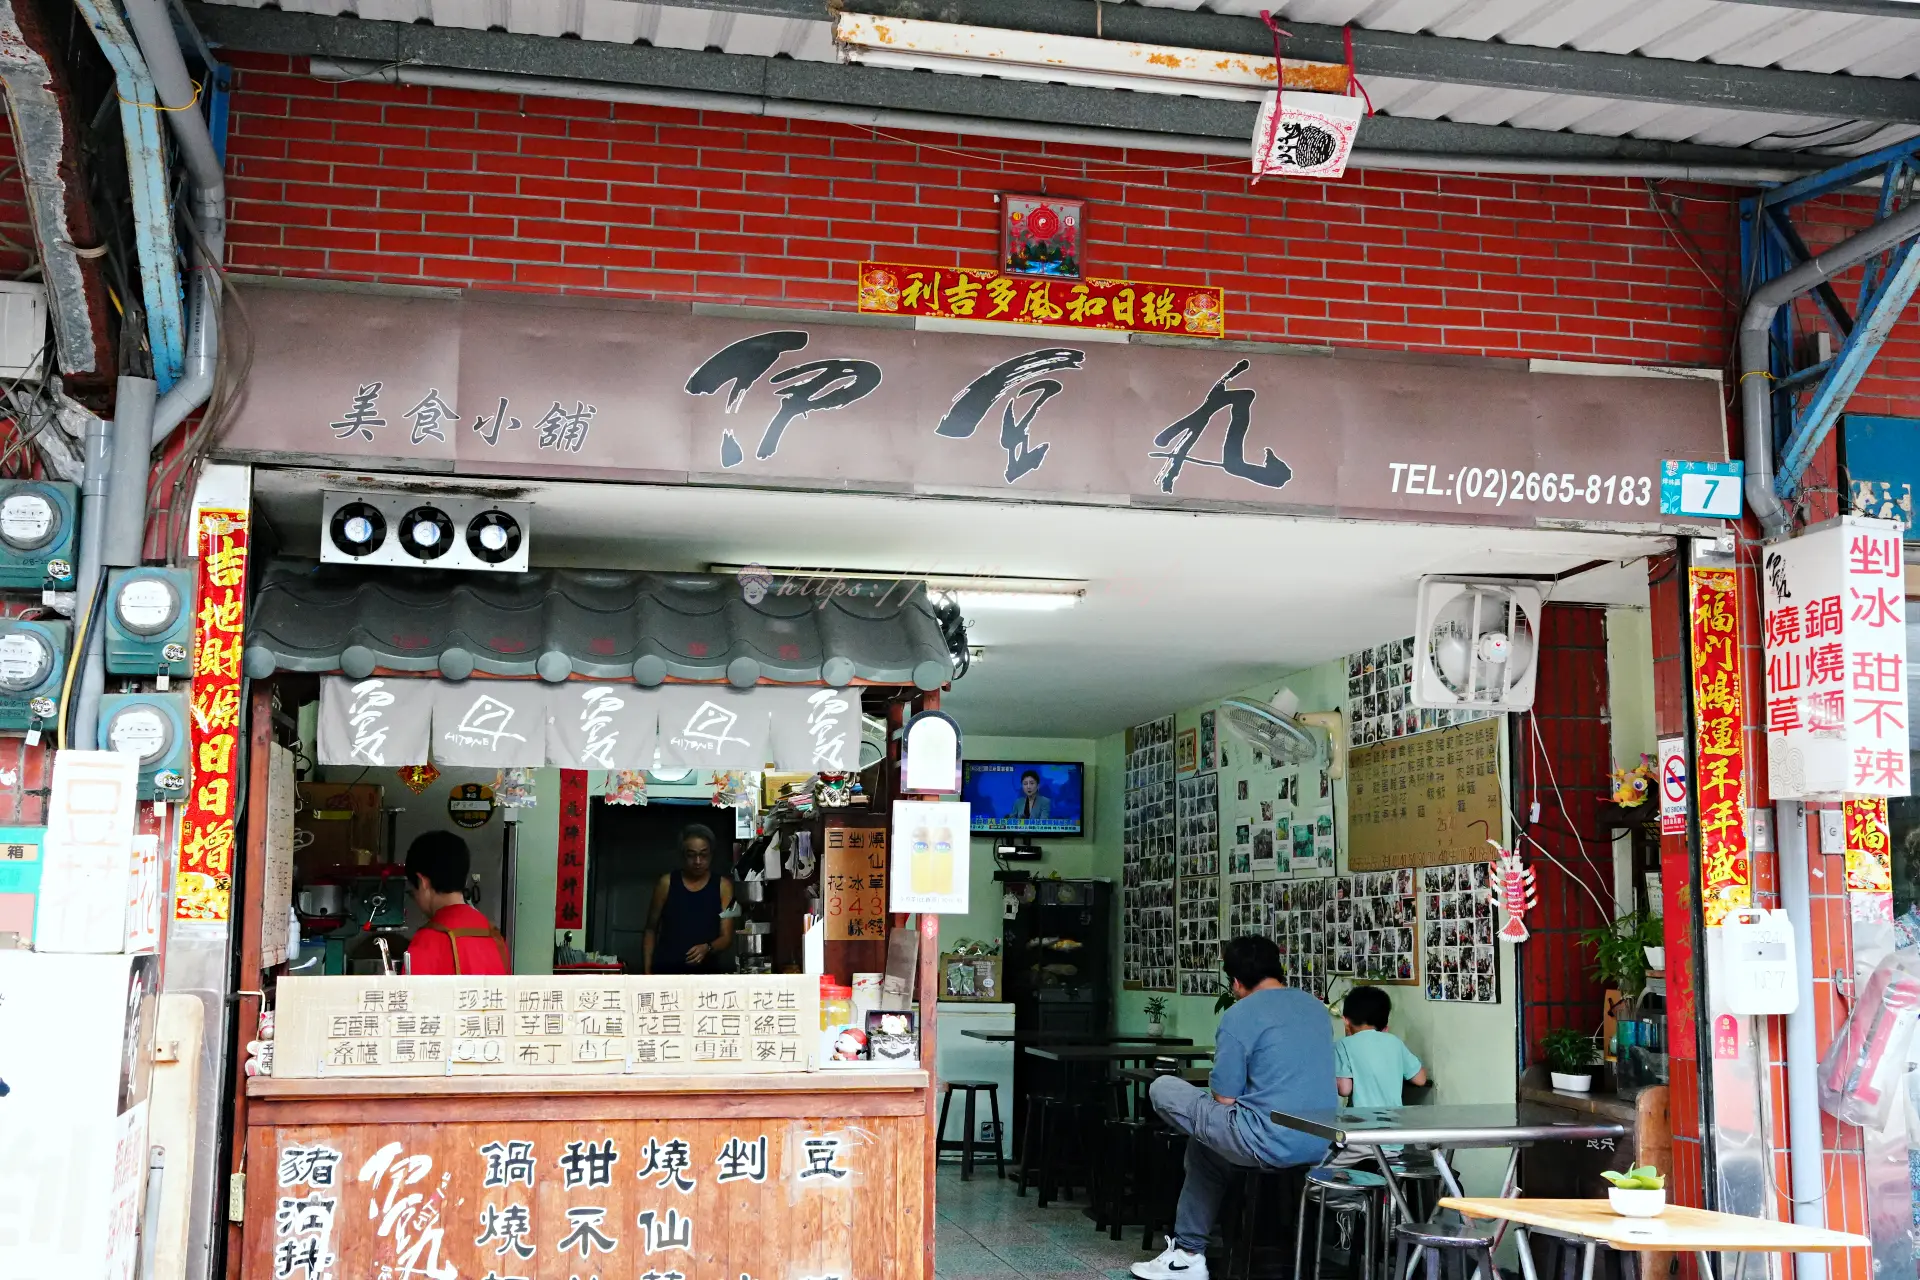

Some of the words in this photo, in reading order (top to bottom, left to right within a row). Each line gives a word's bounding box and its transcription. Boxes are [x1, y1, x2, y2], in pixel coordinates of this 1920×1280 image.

[329, 381, 598, 453] 美食小舖
[1388, 462, 1651, 507] TEL:(02)2665-8183
[1702, 479, 1720, 509] 7
[1849, 534, 1903, 628] 剉冰
[1765, 605, 1804, 737] 燒仙草
[1804, 594, 1846, 734] 鍋燒麵
[1851, 652, 1906, 790] 甜不辣
[1694, 592, 1747, 887] 福門鴻運年年盛
[1671, 805, 1687, 813] SMOKIN
[828, 831, 844, 890] 豆花
[848, 832, 864, 890] 剉冰
[868, 832, 885, 889] 燒仙草
[364, 990, 408, 1012] 果醬
[459, 989, 503, 1009] 珍珠
[520, 991, 563, 1010] 粉粿
[579, 990, 621, 1010] 愛玉
[637, 990, 679, 1013] 鳳梨
[698, 990, 739, 1009] 地瓜
[753, 989, 796, 1009] 花生
[333, 1016, 379, 1036] 百香果
[397, 1015, 441, 1036] 草莓
[460, 1015, 504, 1037] 湯圓
[581, 1015, 623, 1035] 仙草
[638, 1014, 681, 1035] 花豆
[698, 1014, 741, 1036] 紅豆
[754, 1014, 797, 1035] 綠豆
[334, 1041, 378, 1065] 桑椹
[519, 1044, 562, 1064] 布丁
[637, 1039, 681, 1062] 薏仁
[695, 1039, 739, 1060] 雪蓮
[757, 1041, 797, 1061] 麥片
[473, 1140, 538, 1280] 鍋燒
[558, 1139, 618, 1280] 甜不
[637, 1138, 696, 1280] 燒仙
[716, 1136, 768, 1280] 剉
